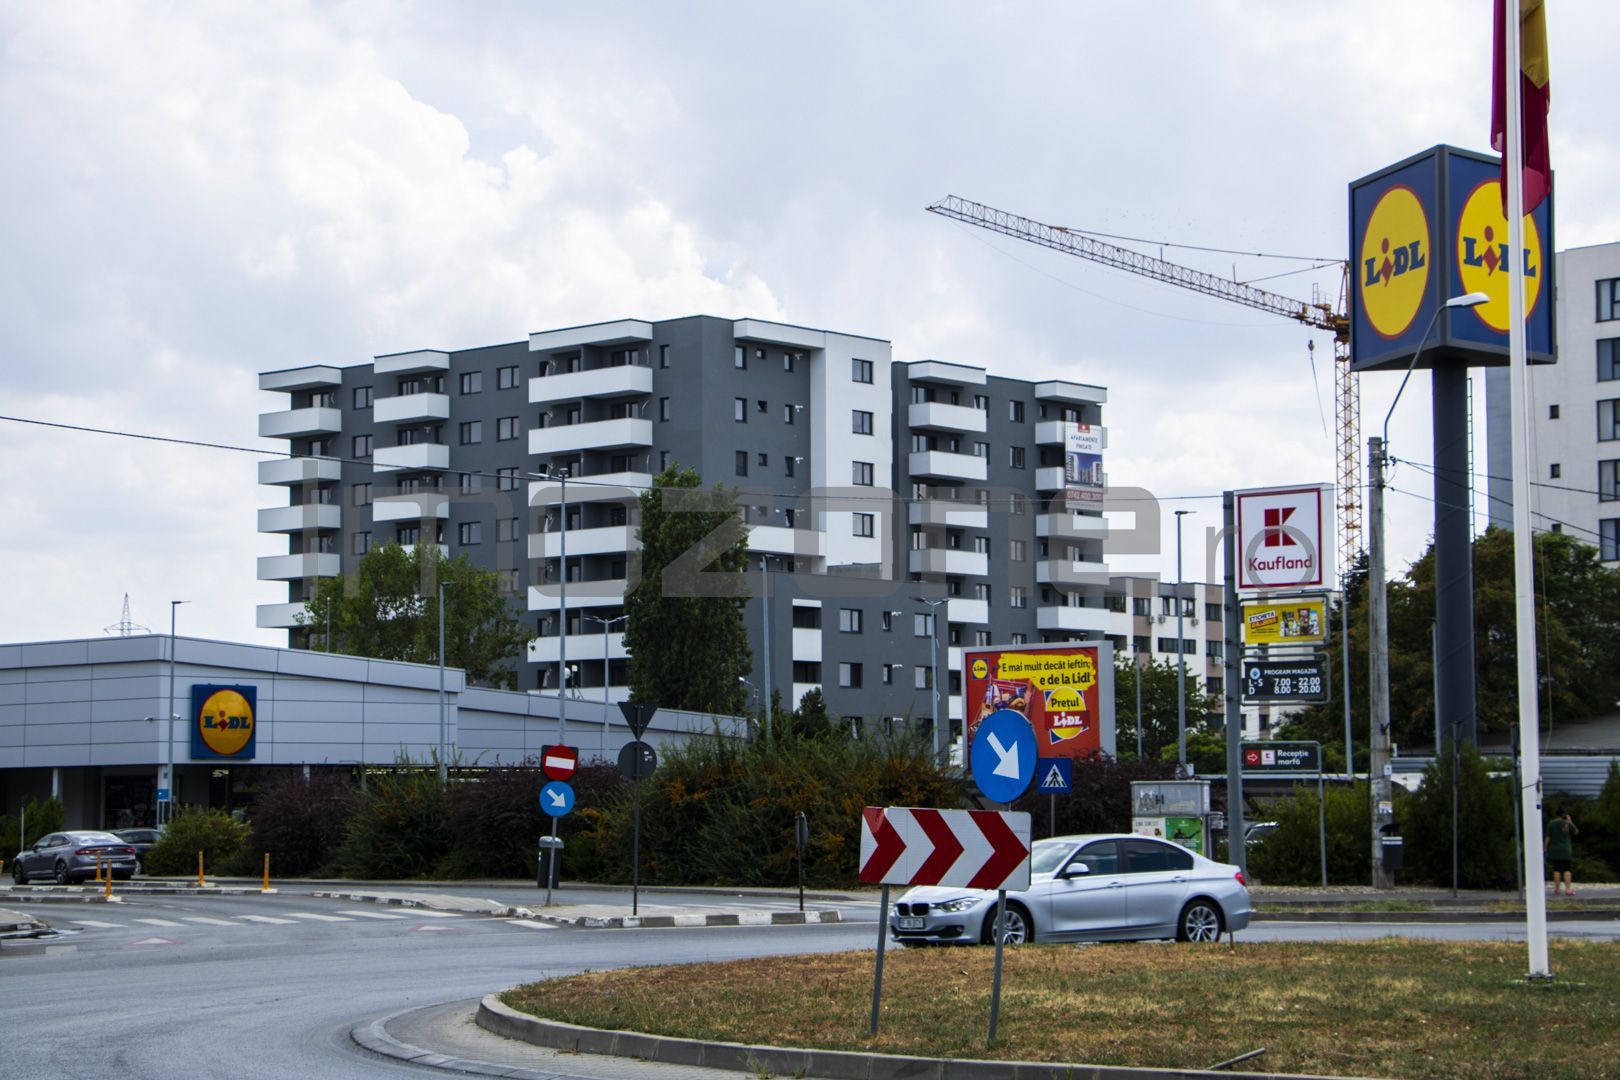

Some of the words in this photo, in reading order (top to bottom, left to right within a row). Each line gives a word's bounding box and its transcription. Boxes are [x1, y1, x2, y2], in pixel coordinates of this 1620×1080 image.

[1264, 507, 1297, 547] K
[1248, 554, 1313, 571] Kaufland
[1002, 663, 1006, 672] E
[1009, 662, 1022, 671] mai
[1024, 661, 1042, 671] mult
[1040, 676, 1045, 685] e
[1047, 674, 1060, 685] de
[1061, 673, 1070, 684] la
[1072, 672, 1091, 684] Lidl
[1274, 678, 1291, 687] 7.00
[1298, 677, 1320, 686] 22.00
[1249, 687, 1256, 695] D
[1274, 686, 1291, 694] 8.00
[1298, 685, 1320, 694] 20.00
[1051, 697, 1080, 710] Prețul
